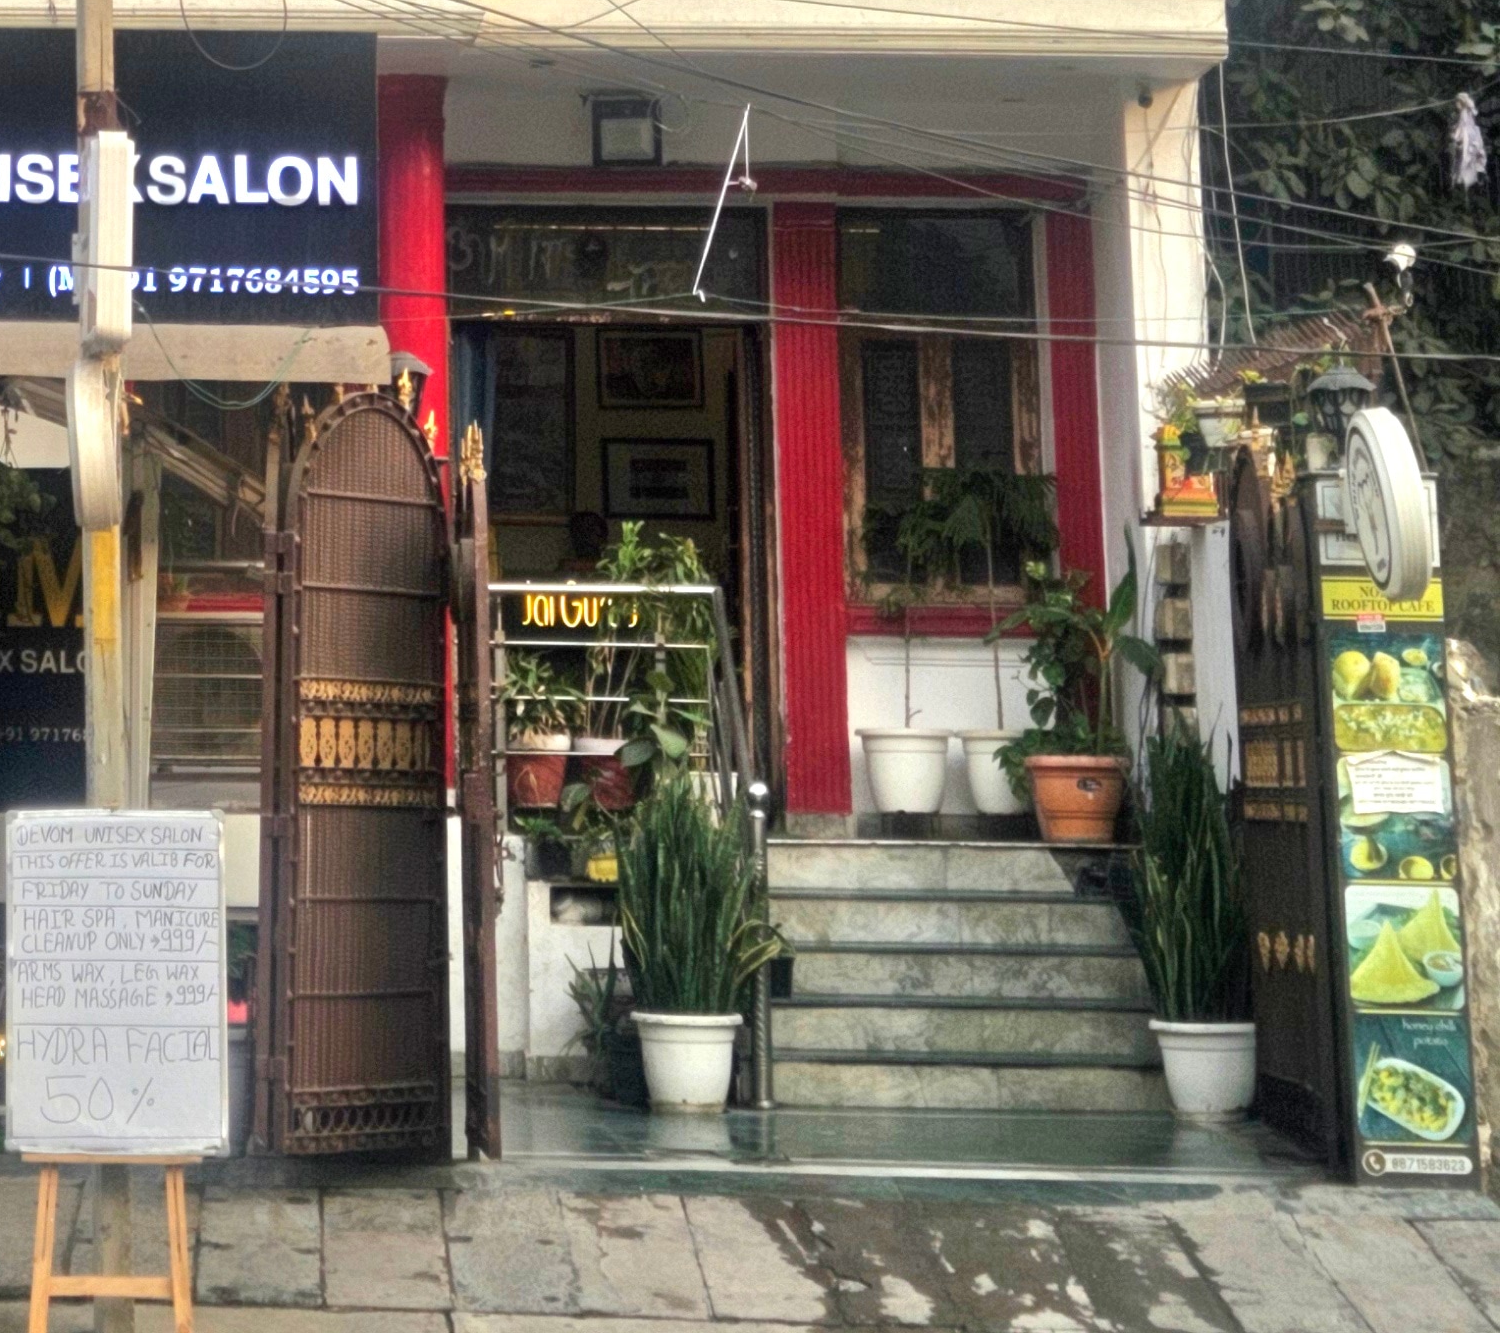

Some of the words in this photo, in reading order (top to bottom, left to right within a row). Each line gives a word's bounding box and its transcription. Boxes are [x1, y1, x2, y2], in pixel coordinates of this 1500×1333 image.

[146, 153, 359, 206] SALON
[16, 826, 74, 846] DEVOM
[85, 826, 146, 844] UNISEX
[151, 826, 204, 845] SALON
[16, 854, 54, 870] THIS
[58, 852, 106, 870] OFFER
[110, 852, 129, 869] IS
[182, 852, 216, 869] FOR
[21, 880, 90, 900] FRIDAY
[99, 881, 125, 900] TO
[130, 880, 199, 902] SUNDAY
[23, 908, 74, 931] HAIR
[135, 909, 220, 929] MANICURE
[21, 933, 98, 954] CLEANUP
[104, 931, 147, 952] ONLY
[17, 961, 62, 983] ARMS
[120, 962, 161, 984] LEG
[166, 963, 200, 981] WAX
[21, 986, 66, 1009] HEAD
[74, 985, 158, 1010] MASSAGE
[16, 1027, 109, 1066] HYDRA
[125, 1026, 220, 1066] FACIAL
